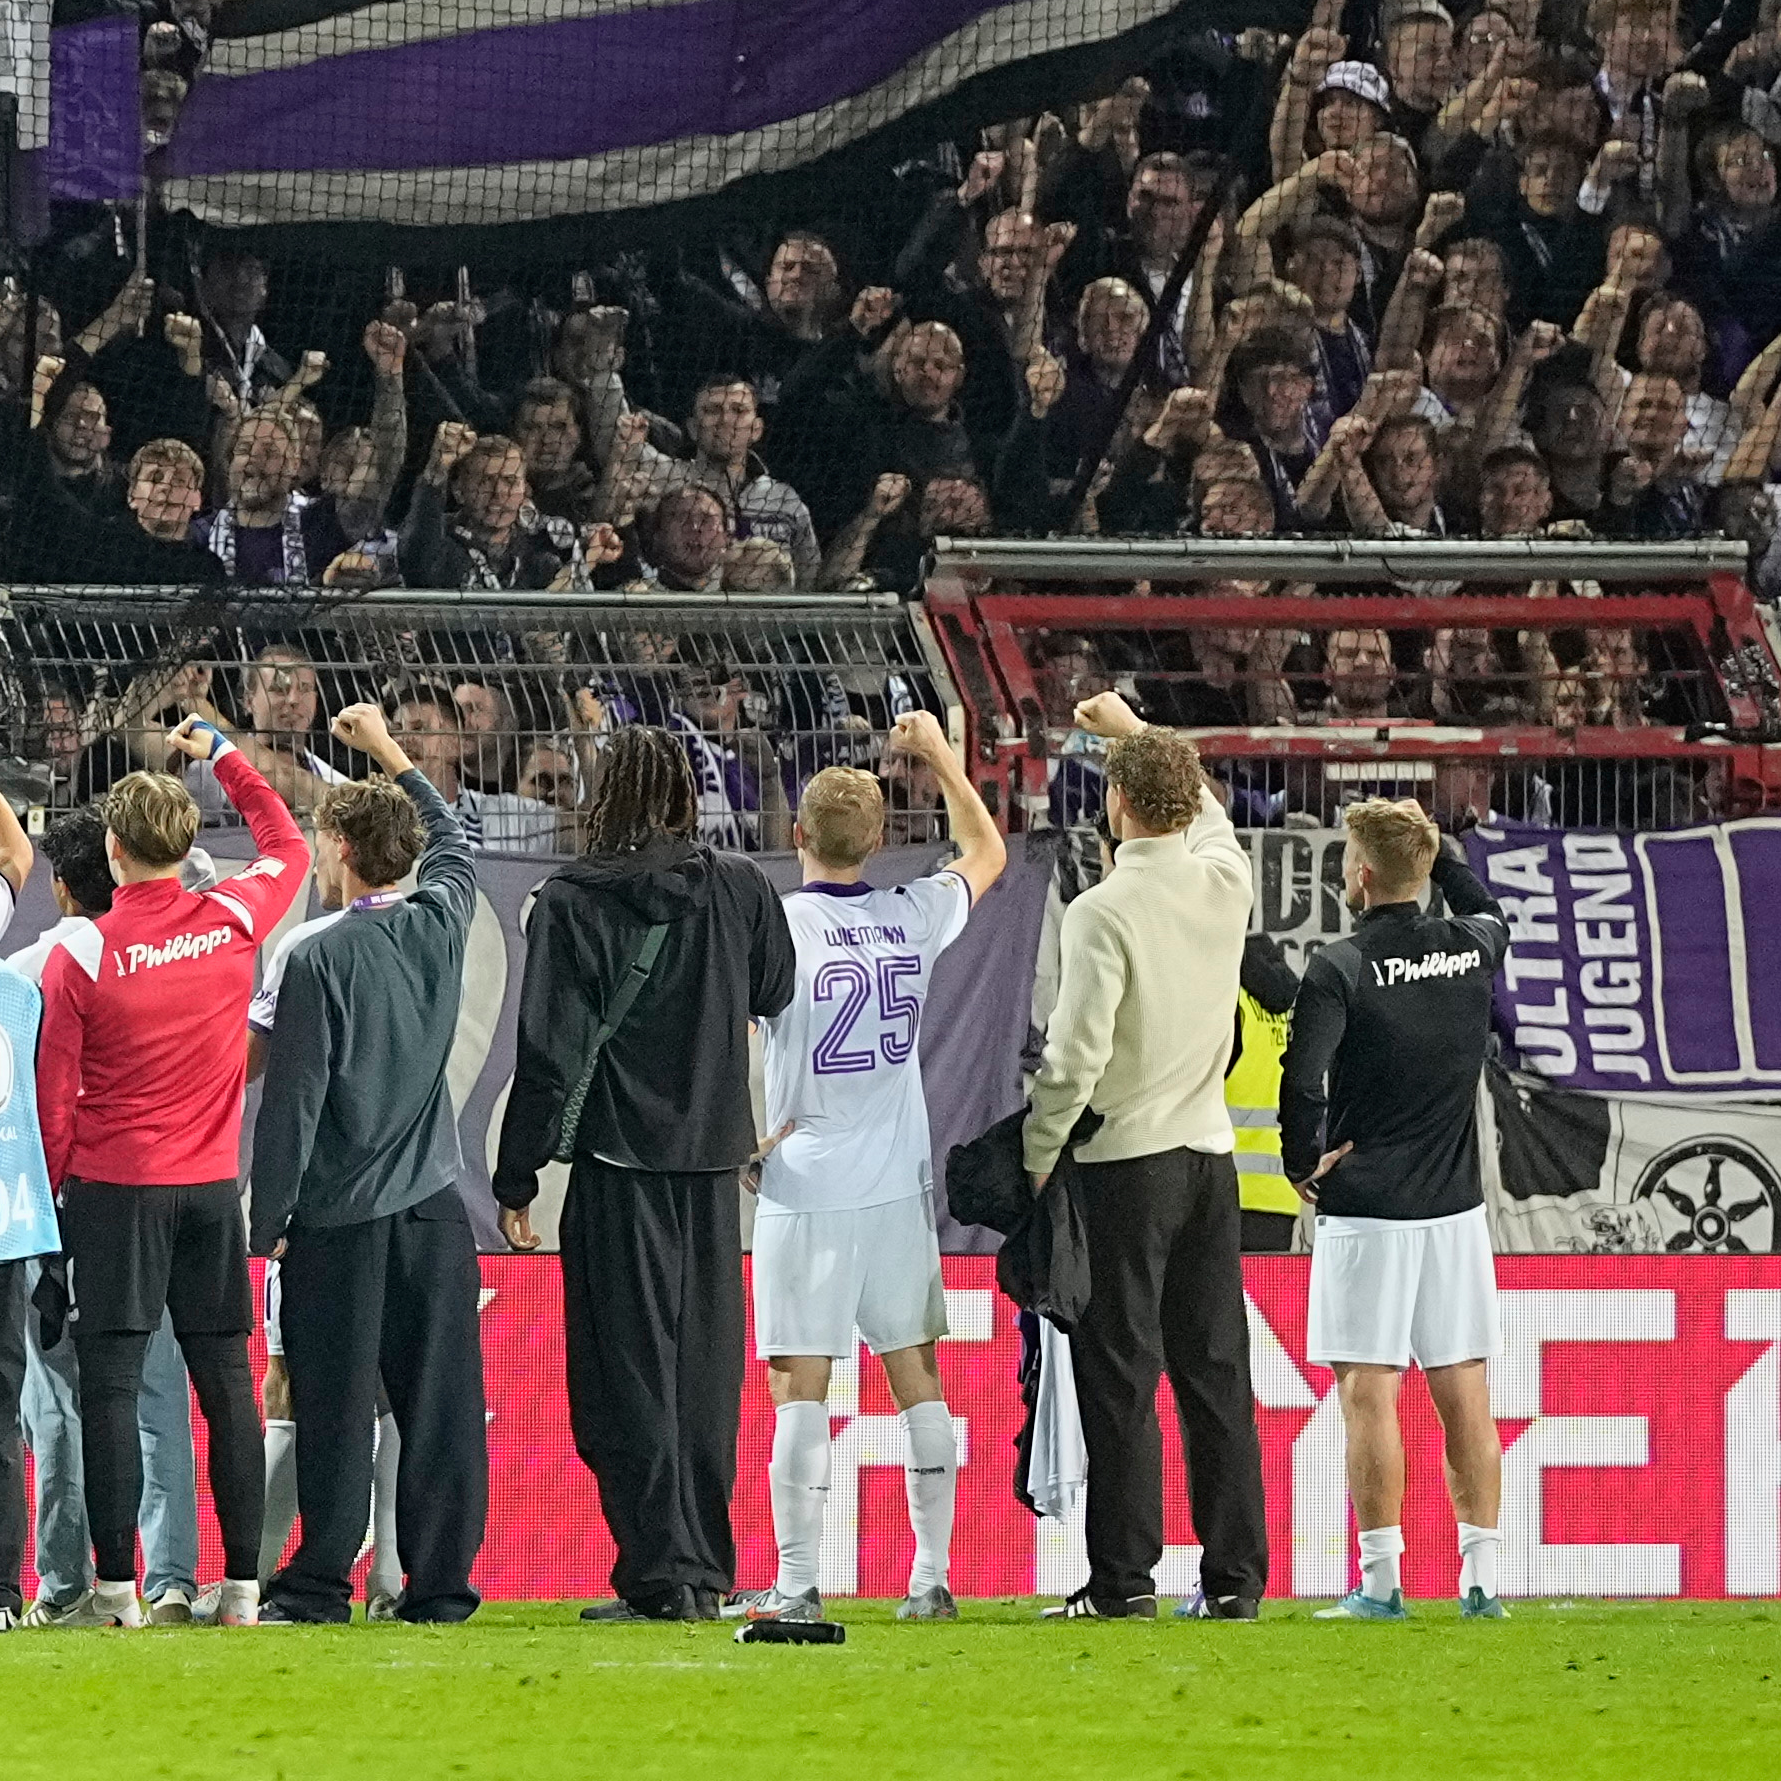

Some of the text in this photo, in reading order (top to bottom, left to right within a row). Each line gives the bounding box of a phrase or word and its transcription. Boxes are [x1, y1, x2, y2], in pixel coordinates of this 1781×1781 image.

[125, 924, 232, 975] Philipps
[1383, 948, 1481, 987] Philipps
[1562, 831, 1653, 1084] JUGEND
[813, 955, 921, 1075] 25
